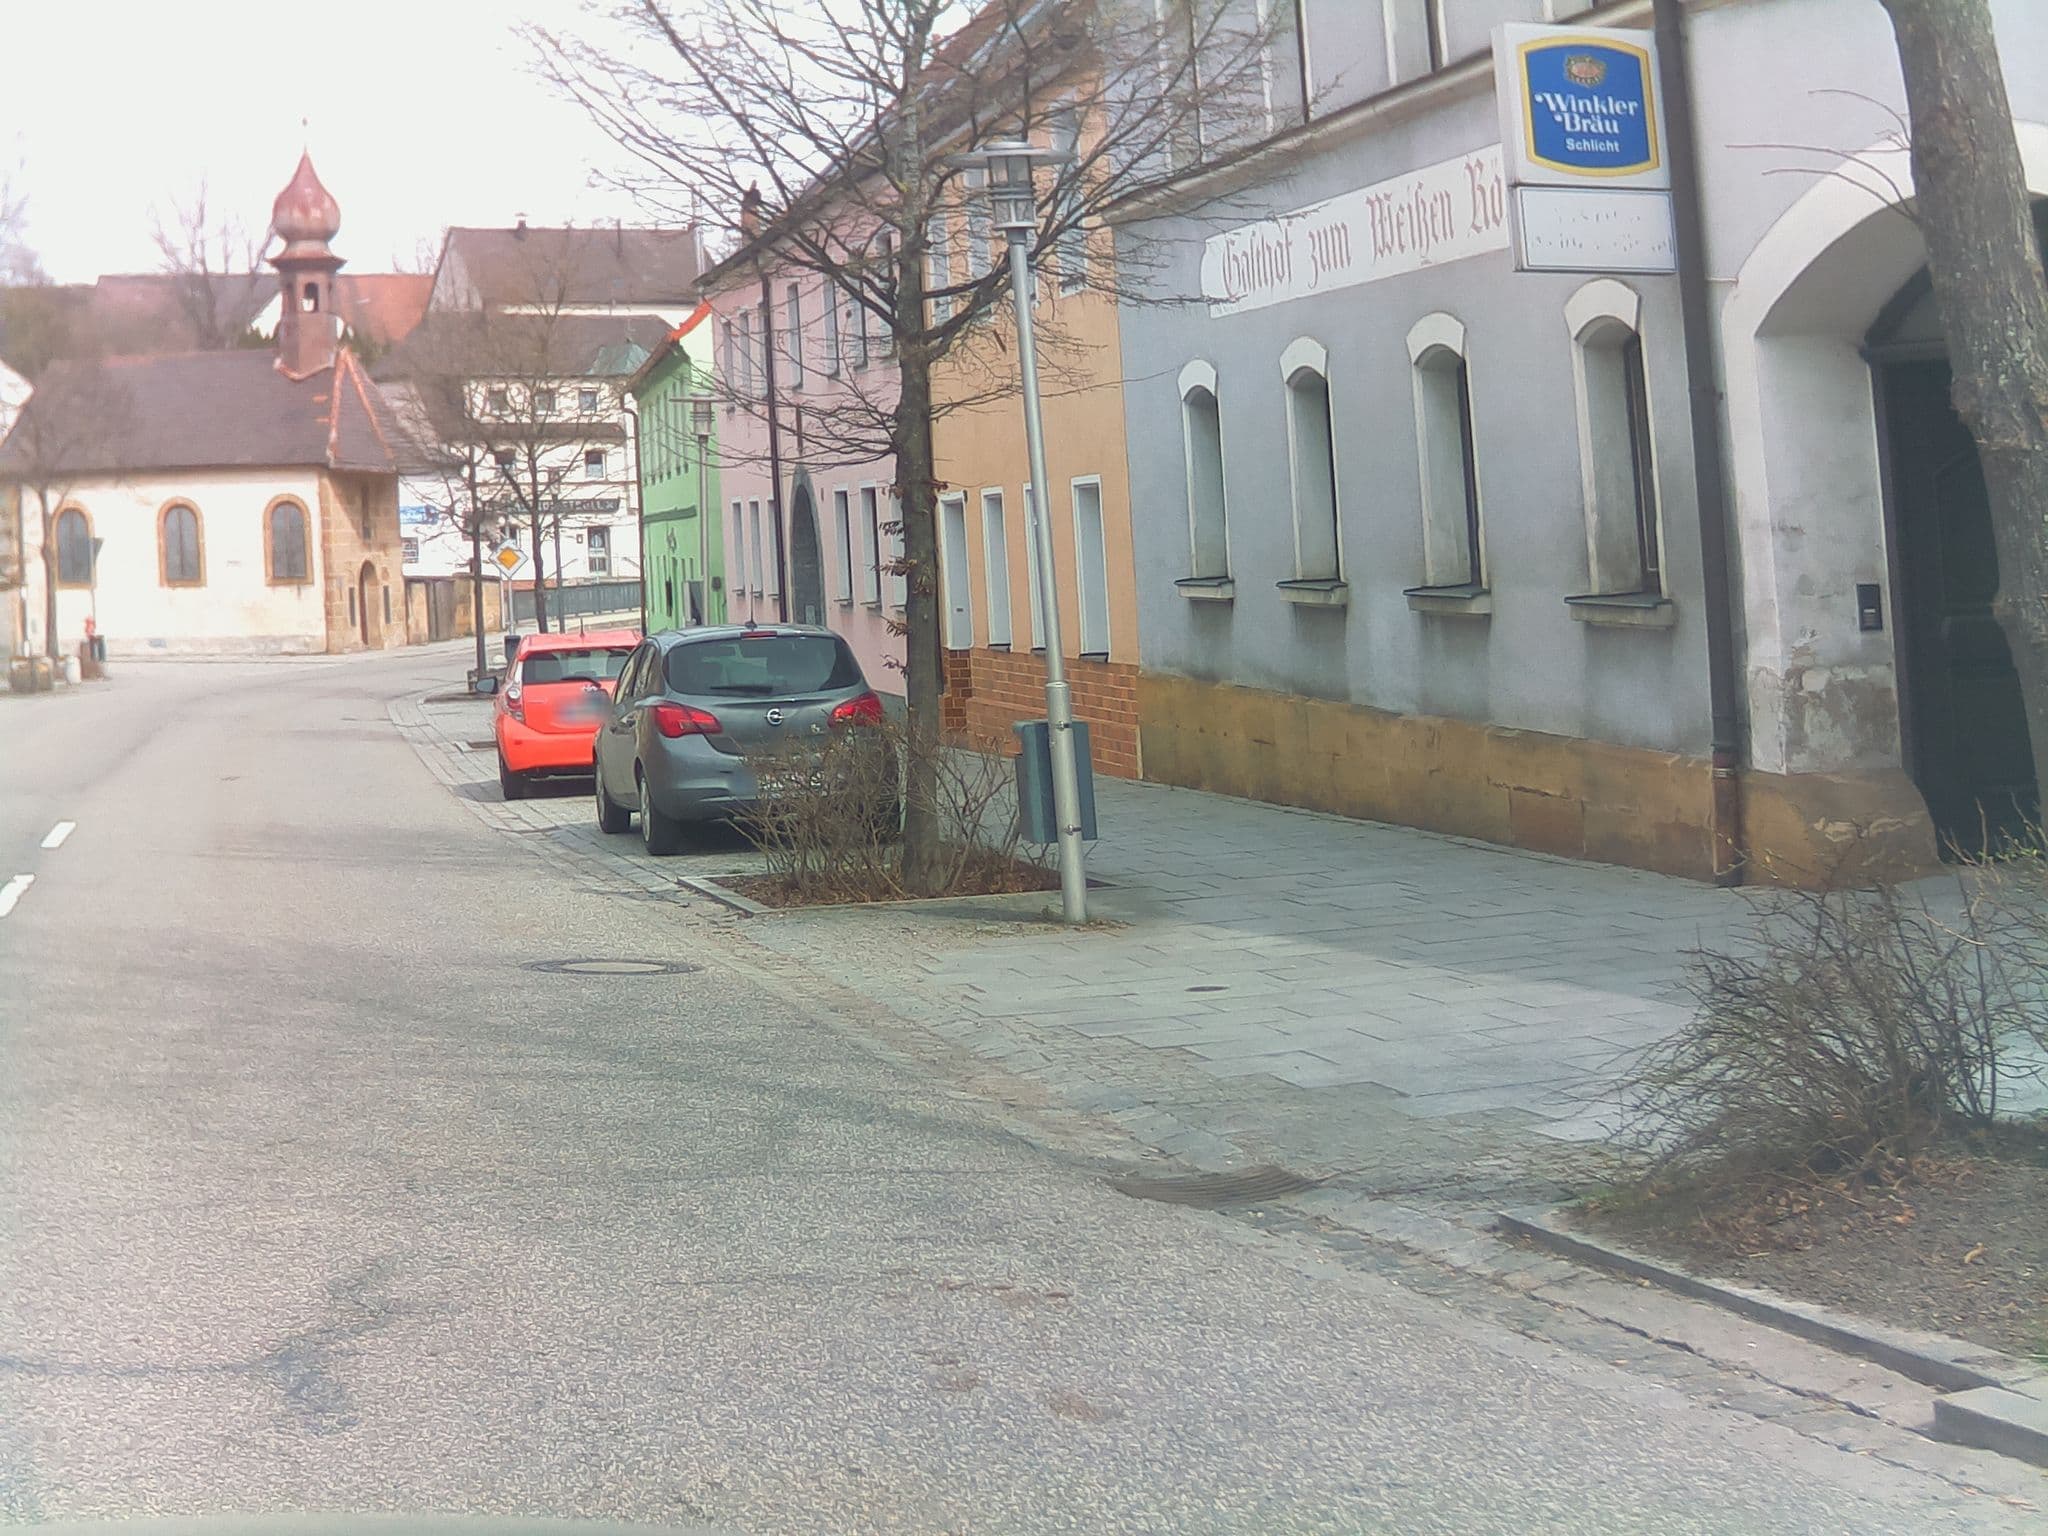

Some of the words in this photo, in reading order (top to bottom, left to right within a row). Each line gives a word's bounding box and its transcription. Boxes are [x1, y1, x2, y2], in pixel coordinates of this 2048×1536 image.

[1534, 92, 1638, 116] Winkler
[1554, 112, 1619, 134] Bräu
[1565, 137, 1620, 153] Schlicht
[1307, 222, 1351, 290] zum
[1365, 180, 1454, 264] Weißen
[1463, 155, 1503, 235] Rö
